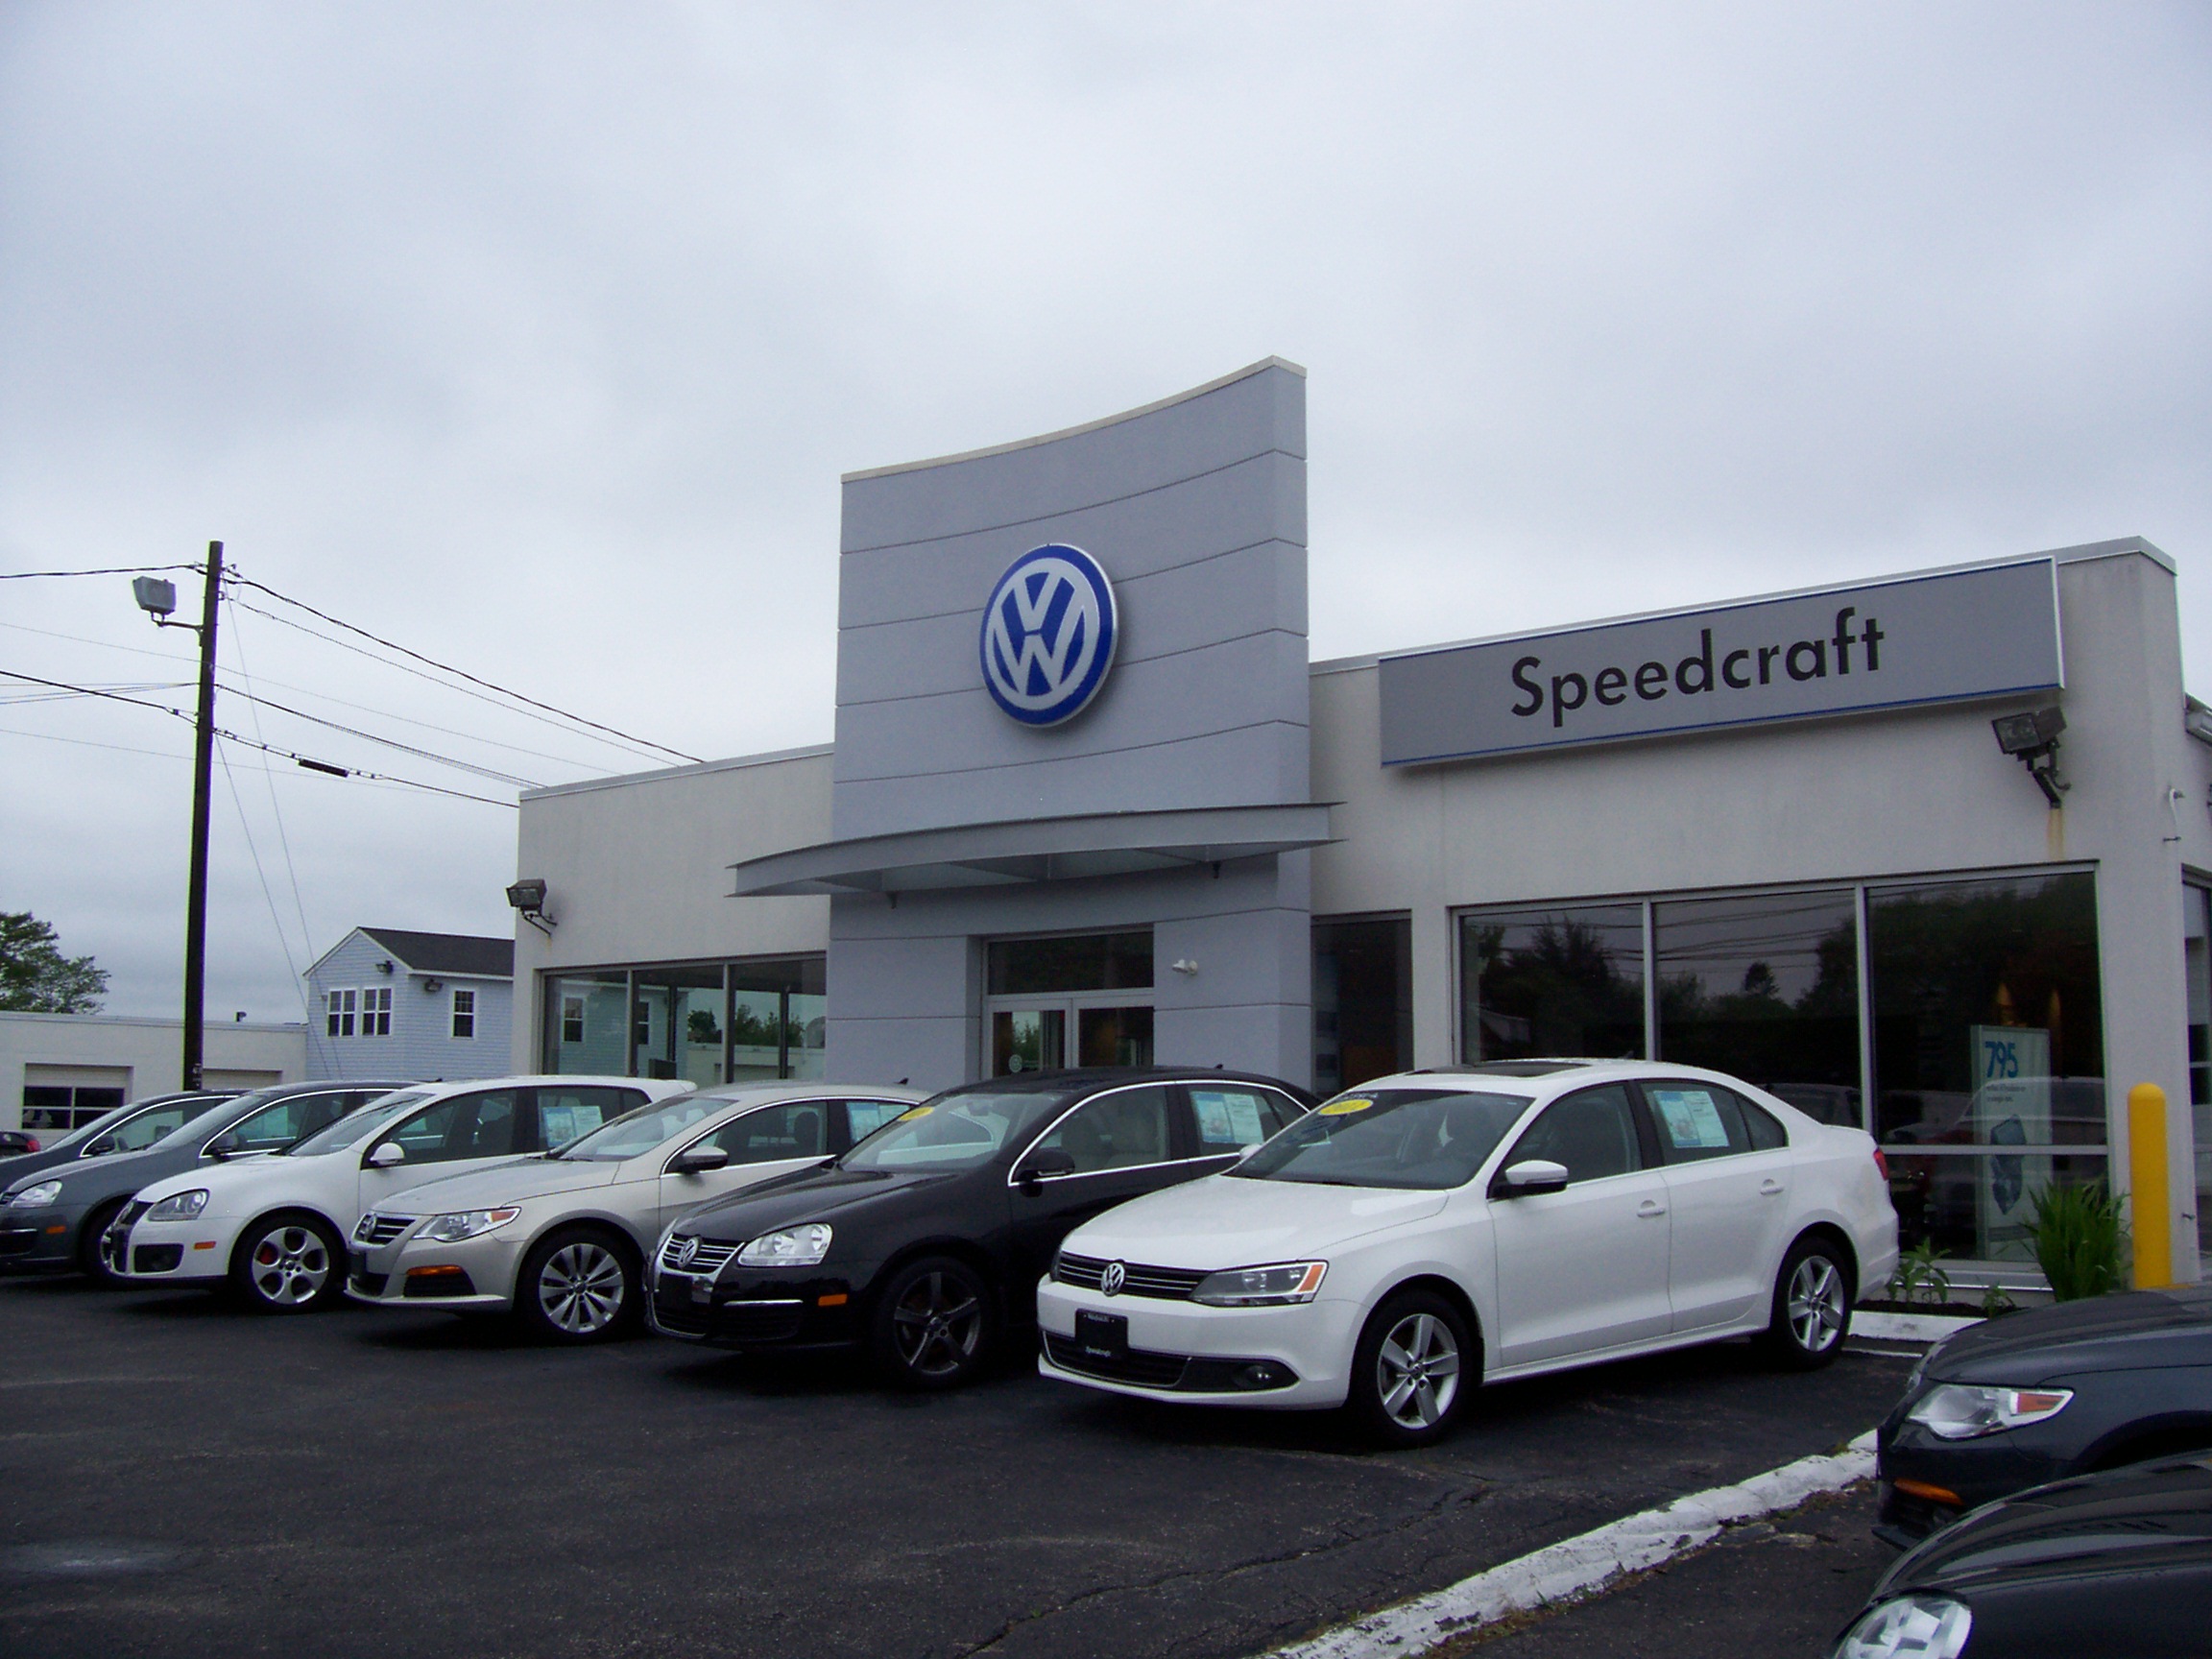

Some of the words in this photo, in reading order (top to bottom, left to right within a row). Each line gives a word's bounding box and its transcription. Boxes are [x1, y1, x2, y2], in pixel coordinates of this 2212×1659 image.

[985, 557, 1100, 711] VW
[1509, 605, 1885, 729] Speedcraft
[1984, 1040, 2019, 1078] 795
